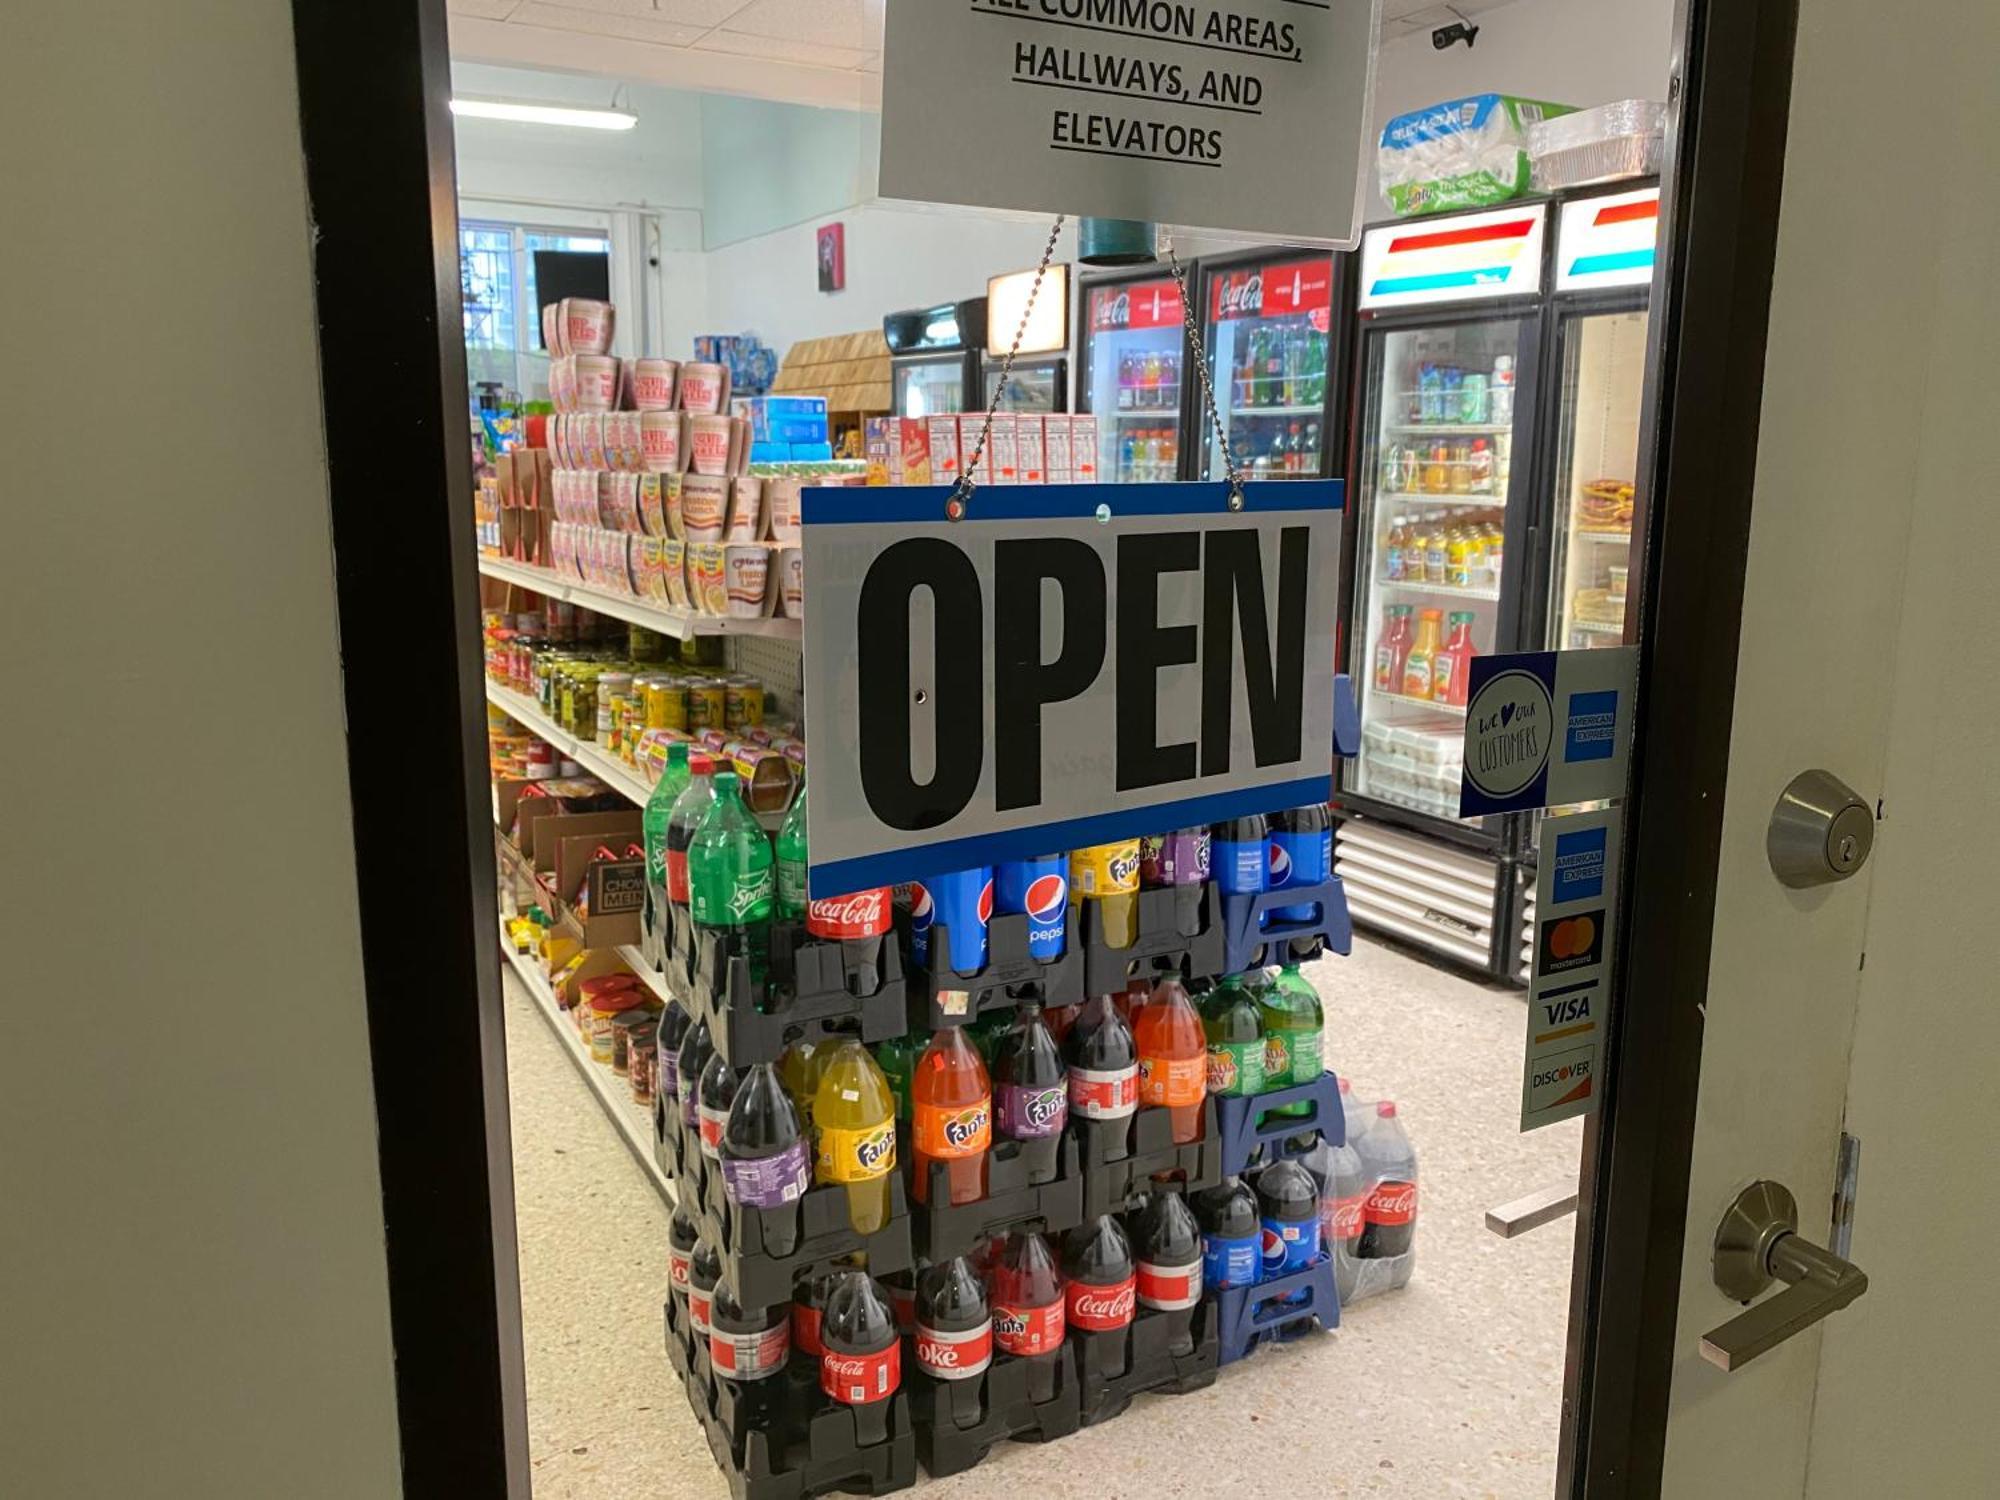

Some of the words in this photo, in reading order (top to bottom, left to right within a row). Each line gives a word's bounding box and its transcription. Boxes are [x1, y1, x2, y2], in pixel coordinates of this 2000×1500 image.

[1203, 11, 1302, 59] AREAS,
[1015, 41, 1190, 101] HALLWAYS,
[1199, 71, 1263, 107] AND
[1052, 110, 1221, 160] ELEVATORS
[857, 526, 1311, 831] OPEN
[1480, 713, 1498, 735] we
[1568, 713, 1613, 728] AMERICAN
[1479, 725, 1537, 773] CUSTOMERS
[1556, 850, 1602, 868] AMERICAN
[1550, 954, 1592, 970] mastercard
[1543, 996, 1590, 1025] VISA
[1533, 1061, 1590, 1088] DISCOVER
